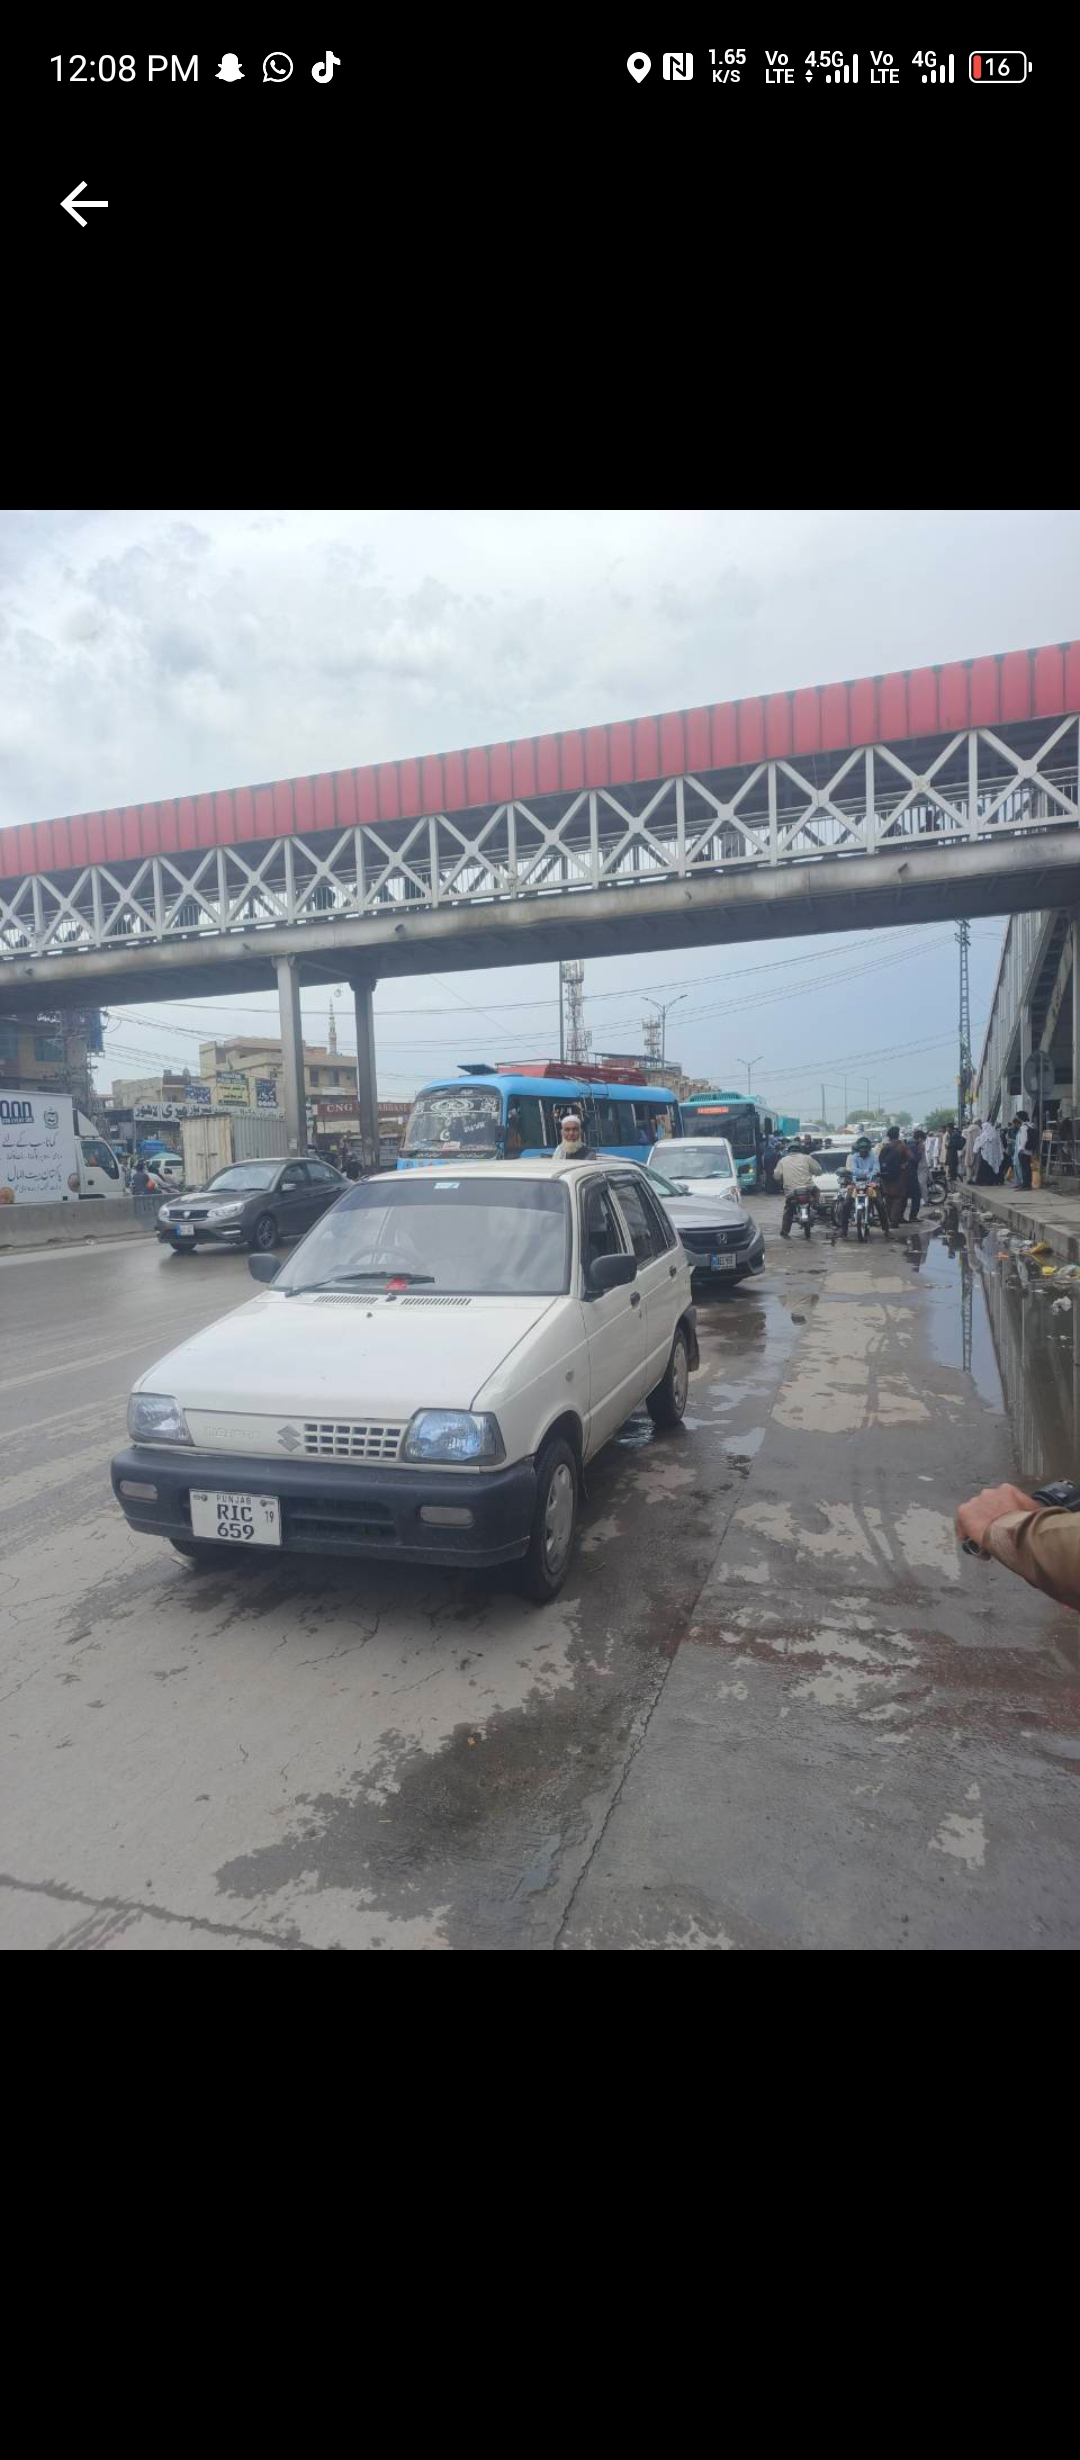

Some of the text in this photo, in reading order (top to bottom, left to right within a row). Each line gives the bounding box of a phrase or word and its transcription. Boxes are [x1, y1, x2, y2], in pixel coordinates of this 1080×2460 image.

[326, 1104, 353, 1112] CNG
[216, 1494, 252, 1505] PUNJAB
[217, 1504, 274, 1523] RIC 19
[217, 1522, 255, 1540] 659
